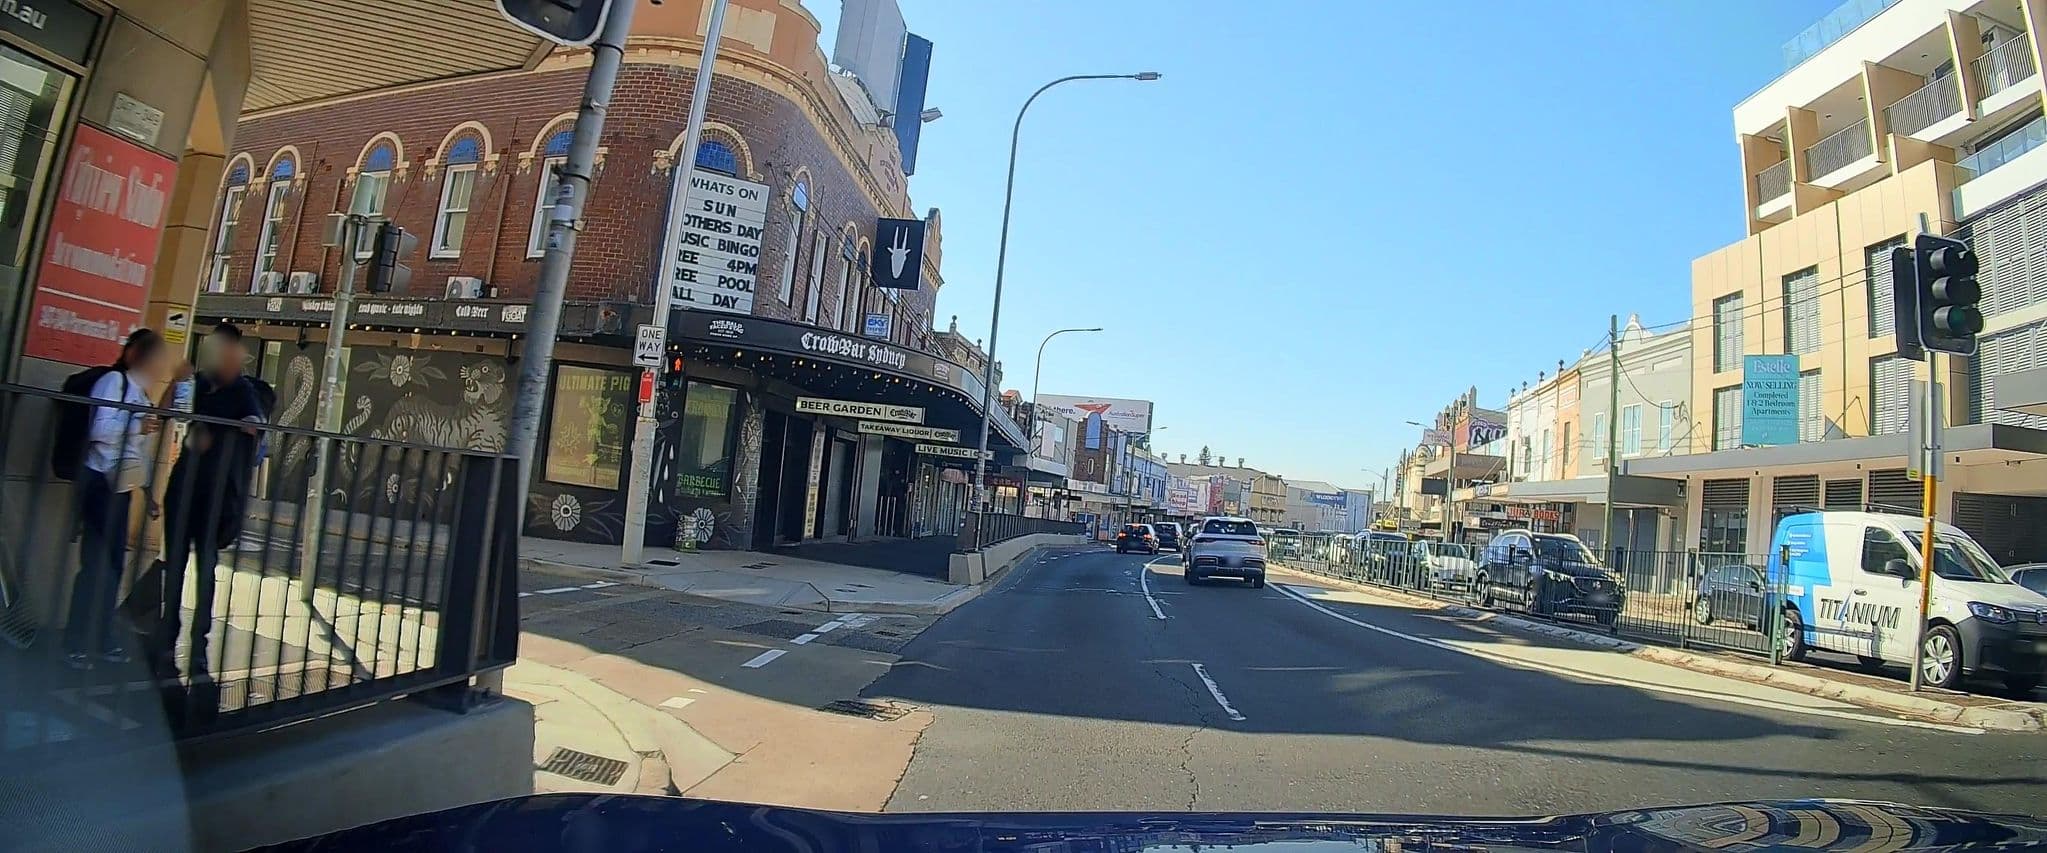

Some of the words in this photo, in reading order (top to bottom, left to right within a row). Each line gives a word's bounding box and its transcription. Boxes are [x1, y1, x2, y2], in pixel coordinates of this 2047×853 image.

[738, 188, 759, 201] ON
[703, 200, 737, 218] SUN
[684, 213, 732, 234] OTHERS
[737, 224, 764, 240] DAY
[681, 231, 710, 248] USIC
[717, 239, 759, 258] BINGO
[726, 259, 757, 276] 4PM
[718, 275, 753, 293] POOL
[712, 293, 739, 309] DAY
[641, 329, 662, 339] ONE
[639, 342, 661, 352] WAY
[867, 345, 906, 369] Sydney
[1753, 359, 1791, 374] Estelle
[560, 374, 606, 391] ULTIMATE
[1746, 381, 1765, 390] NOW
[1765, 381, 1797, 390] SELLING
[1753, 390, 1789, 401] Completed
[1764, 399, 1796, 408] Bedroom
[800, 399, 831, 412] BEER
[833, 402, 882, 418] GARDEN
[1752, 407, 1791, 417] Apartments
[860, 422, 900, 434] TAKEAWAY
[902, 427, 930, 438] LIQUOR
[918, 444, 938, 455] LIVE
[939, 445, 969, 458] MUSIC
[1820, 598, 1902, 630] TITANIUM
